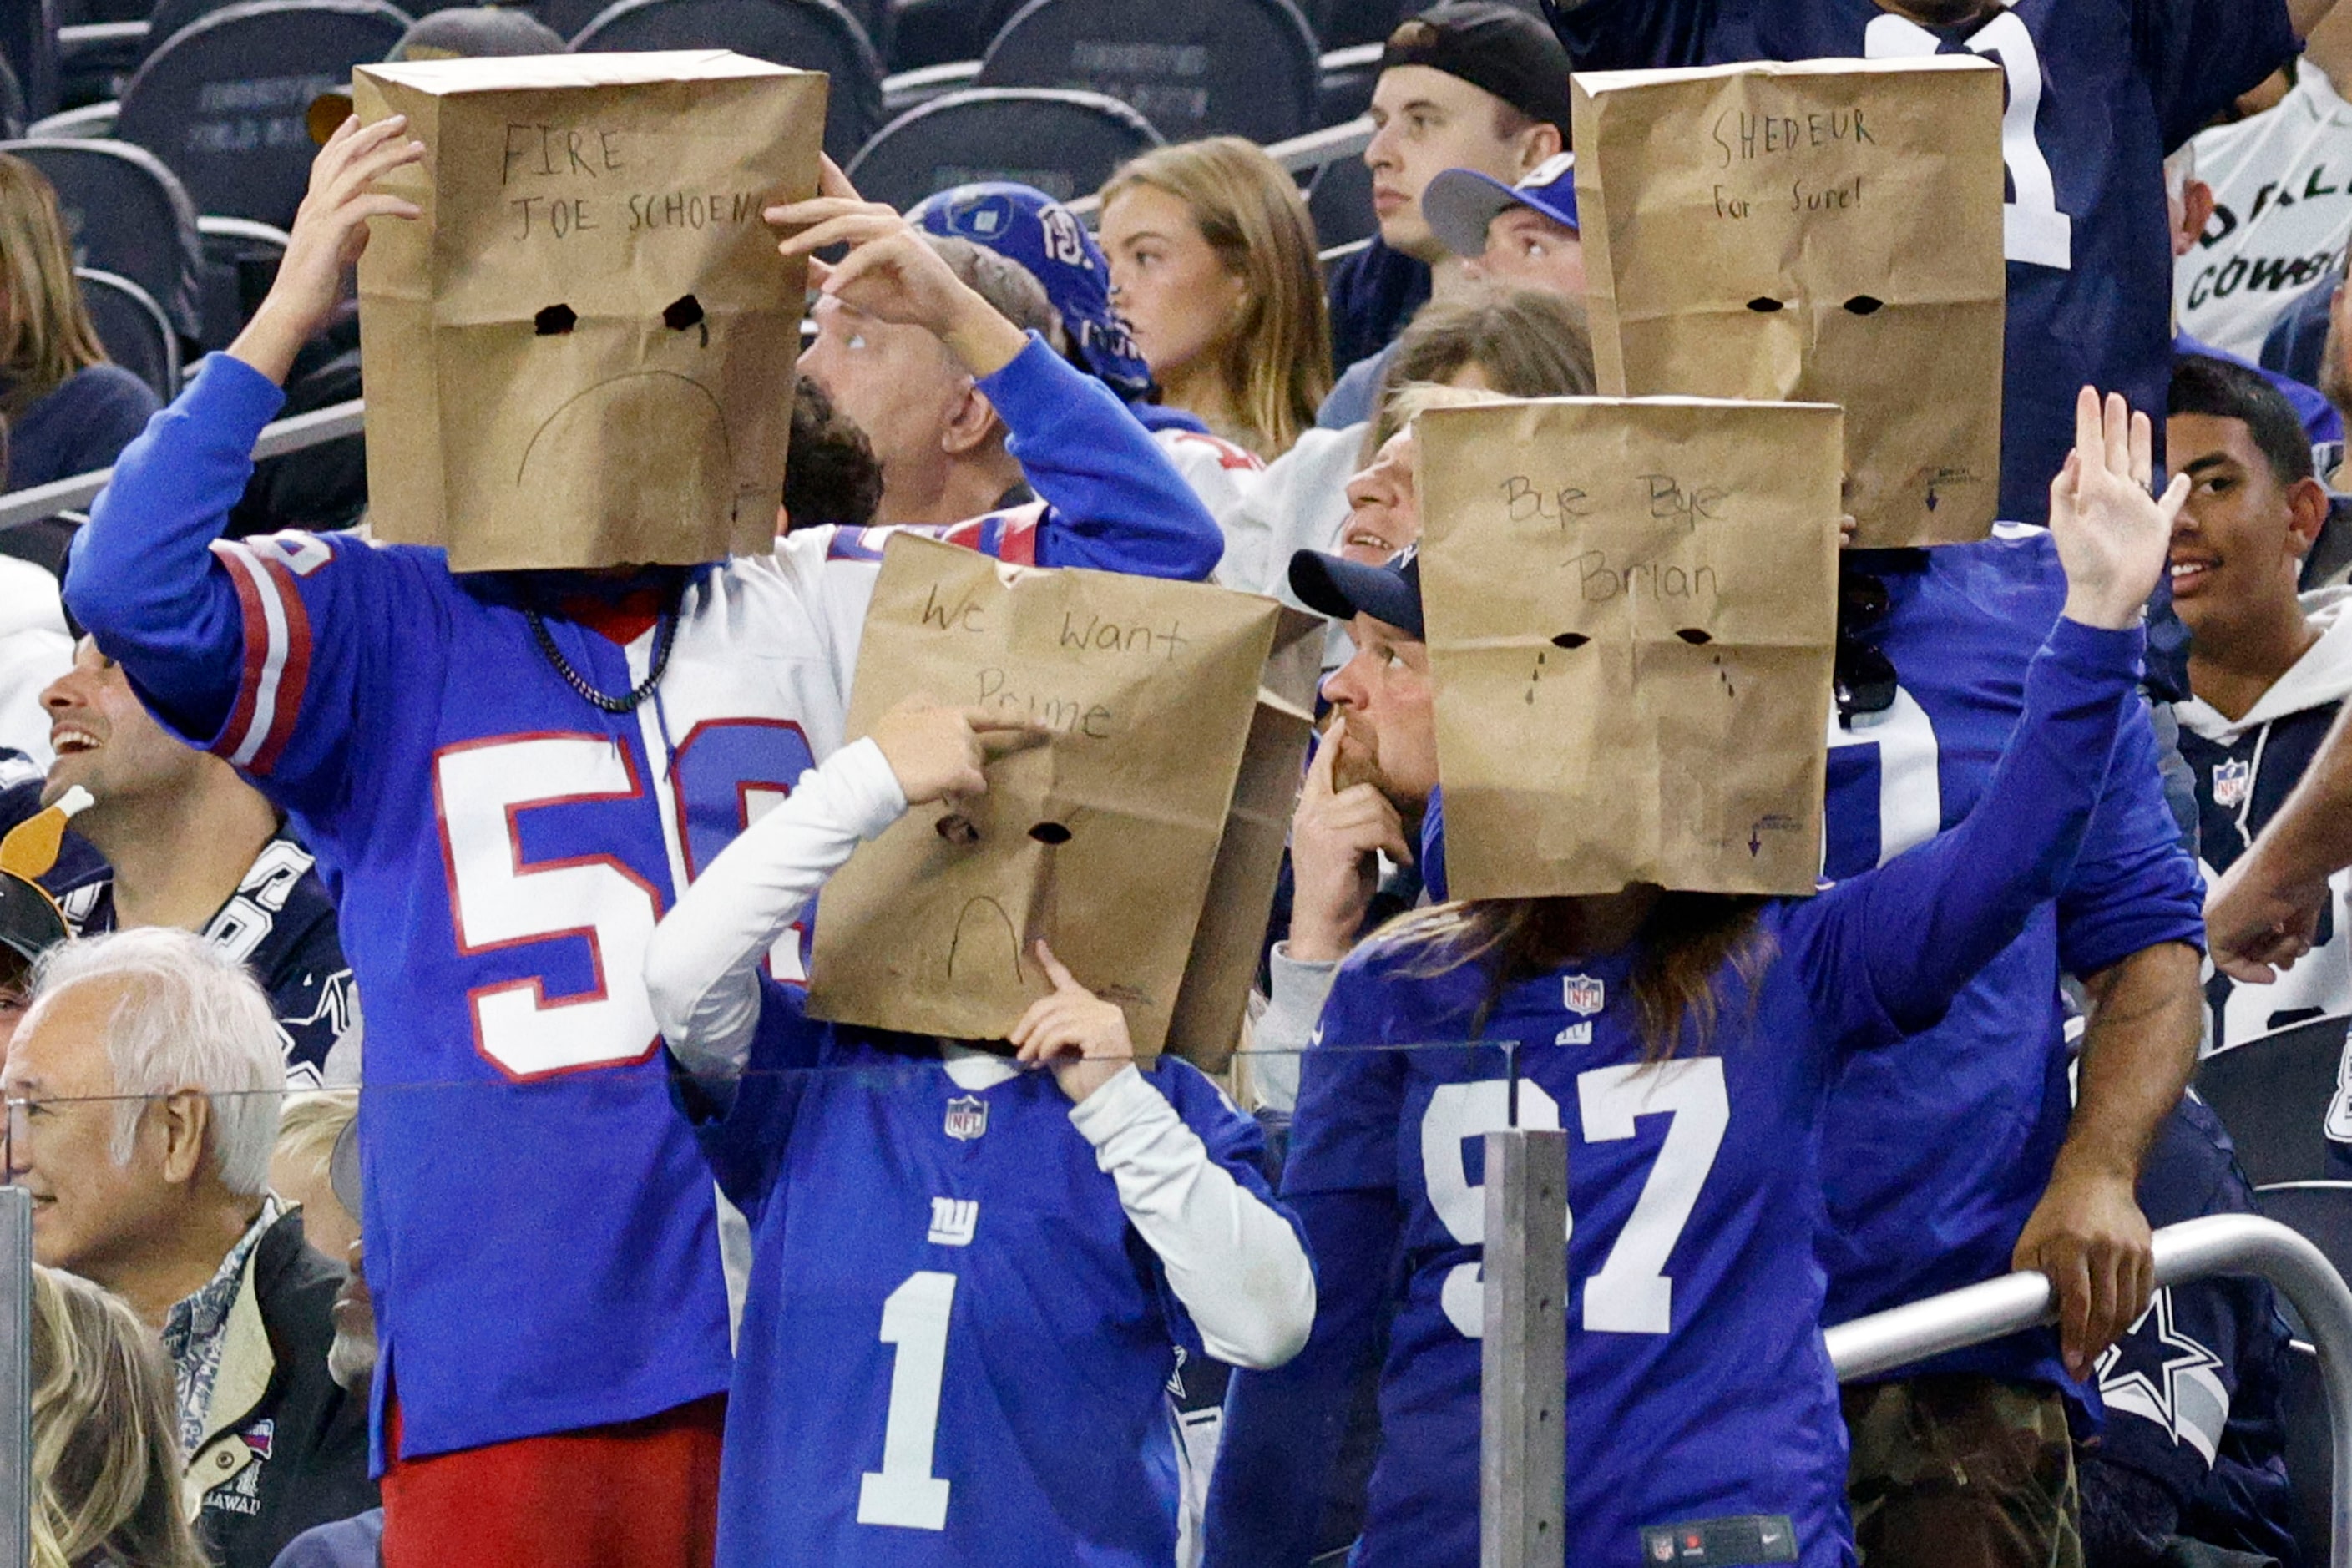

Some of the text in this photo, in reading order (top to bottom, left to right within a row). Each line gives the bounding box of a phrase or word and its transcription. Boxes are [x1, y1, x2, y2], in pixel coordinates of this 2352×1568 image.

[503, 120, 624, 185] FIRE
[1712, 106, 1876, 169] SHEDEUR
[510, 195, 599, 240] JOE
[1713, 175, 1861, 220] For Sure!
[1500, 473, 1732, 531] Bye Bye
[1560, 549, 1718, 603] Brian
[922, 583, 1188, 661] We Want
[856, 1270, 958, 1531] 1
